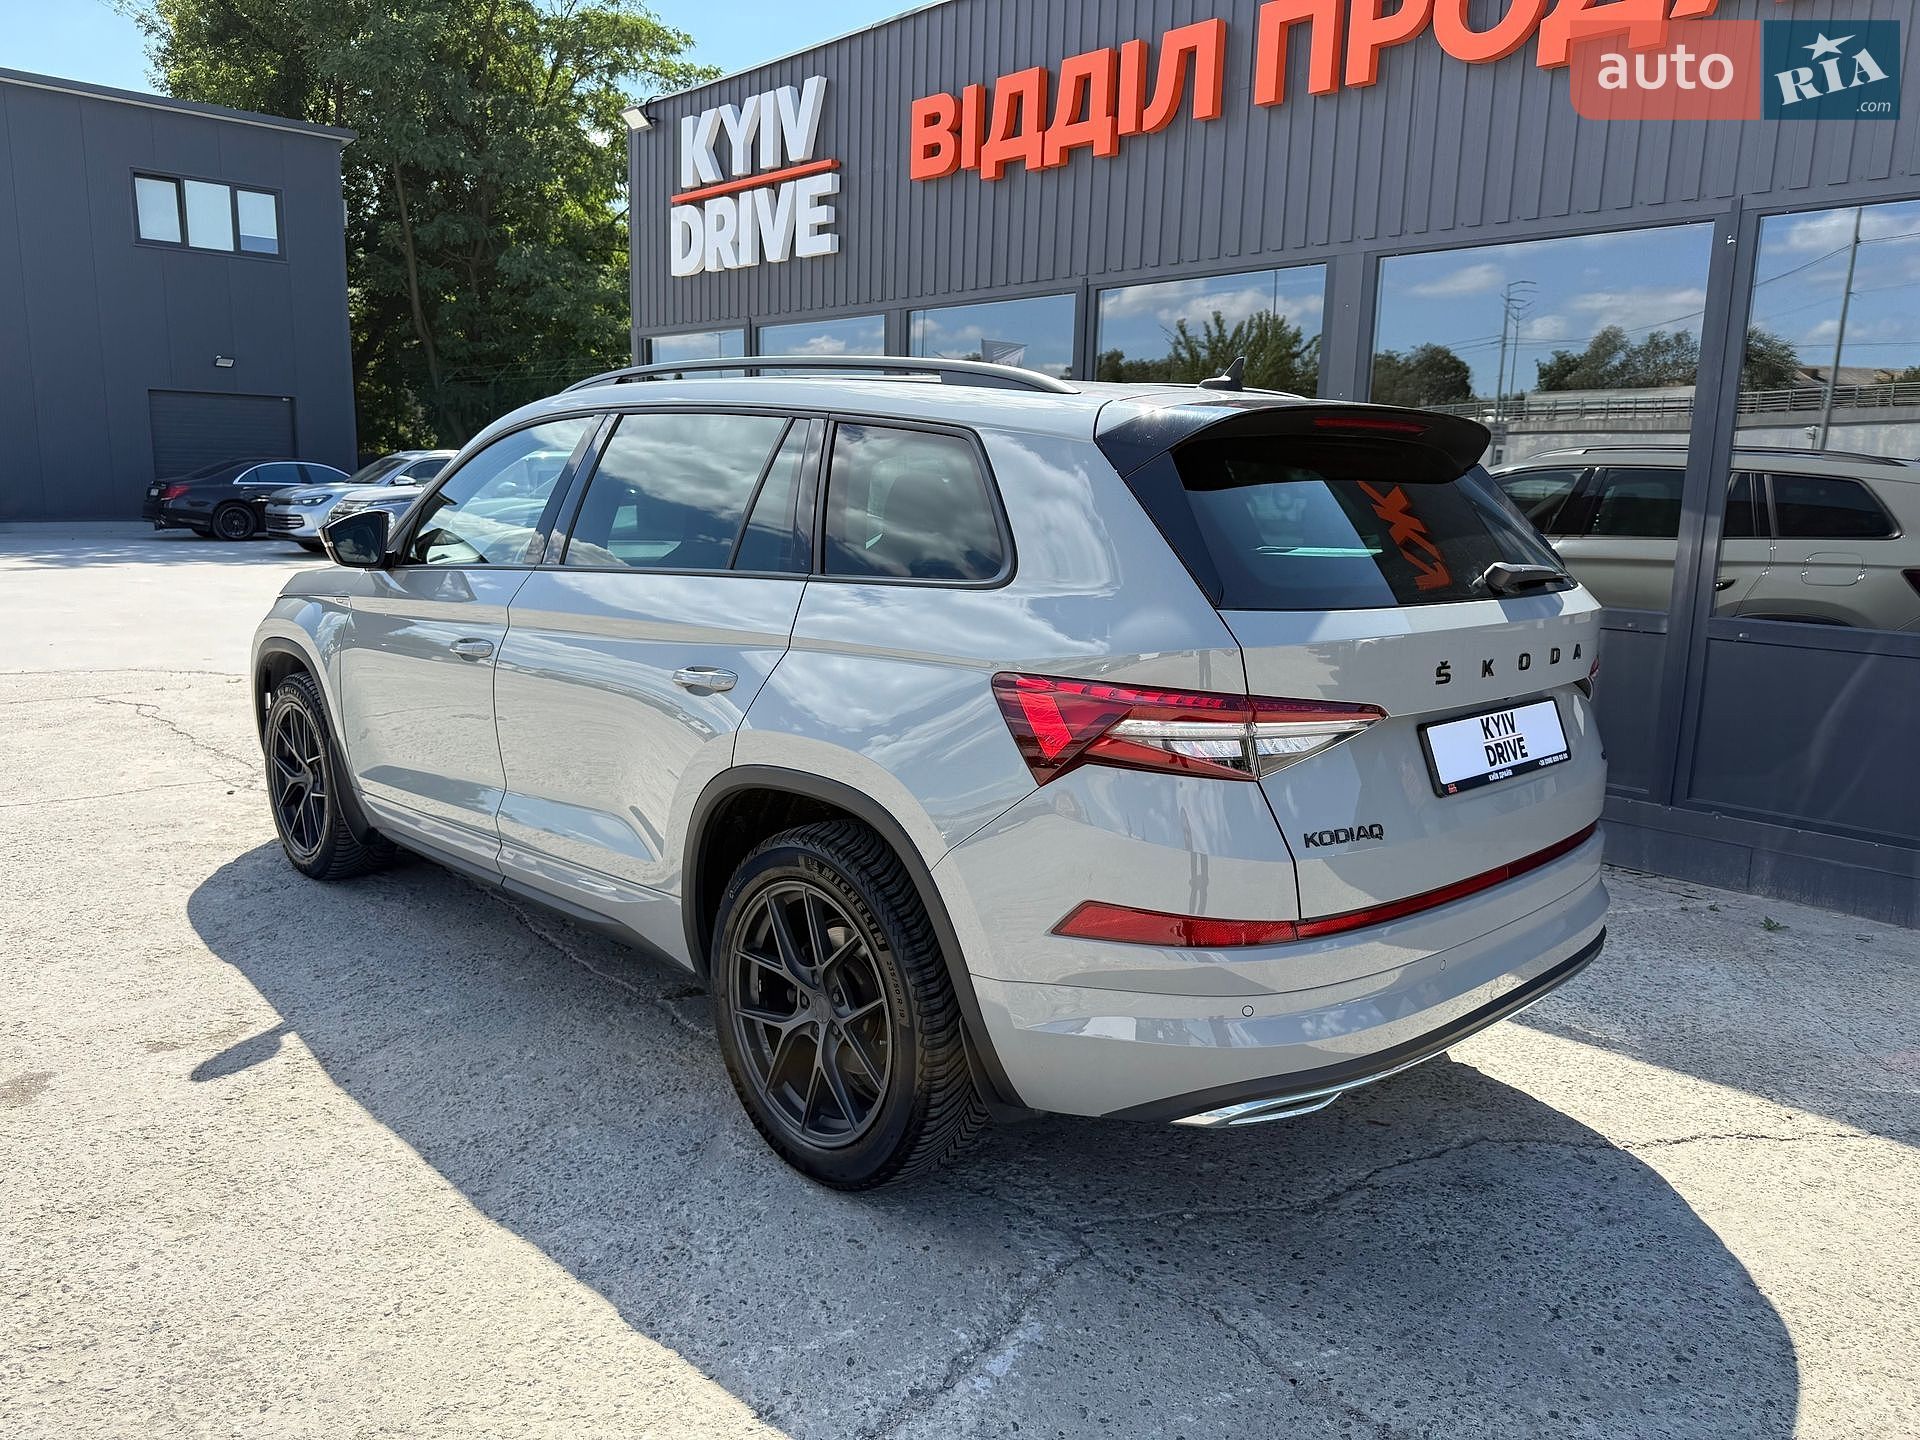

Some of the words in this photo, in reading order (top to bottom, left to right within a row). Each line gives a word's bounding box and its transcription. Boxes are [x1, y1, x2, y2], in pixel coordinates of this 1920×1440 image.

[910, 18, 1226, 181] ВІДДІЛ
[681, 75, 828, 189] KYIV
[670, 172, 840, 277] DRIVE
[1435, 643, 1582, 685] ŠKODA
[1480, 711, 1517, 740] KYIV
[1484, 737, 1528, 767] DRIVE
[1303, 823, 1385, 848] KODIAQ
[821, 867, 890, 951] MICHELIN
